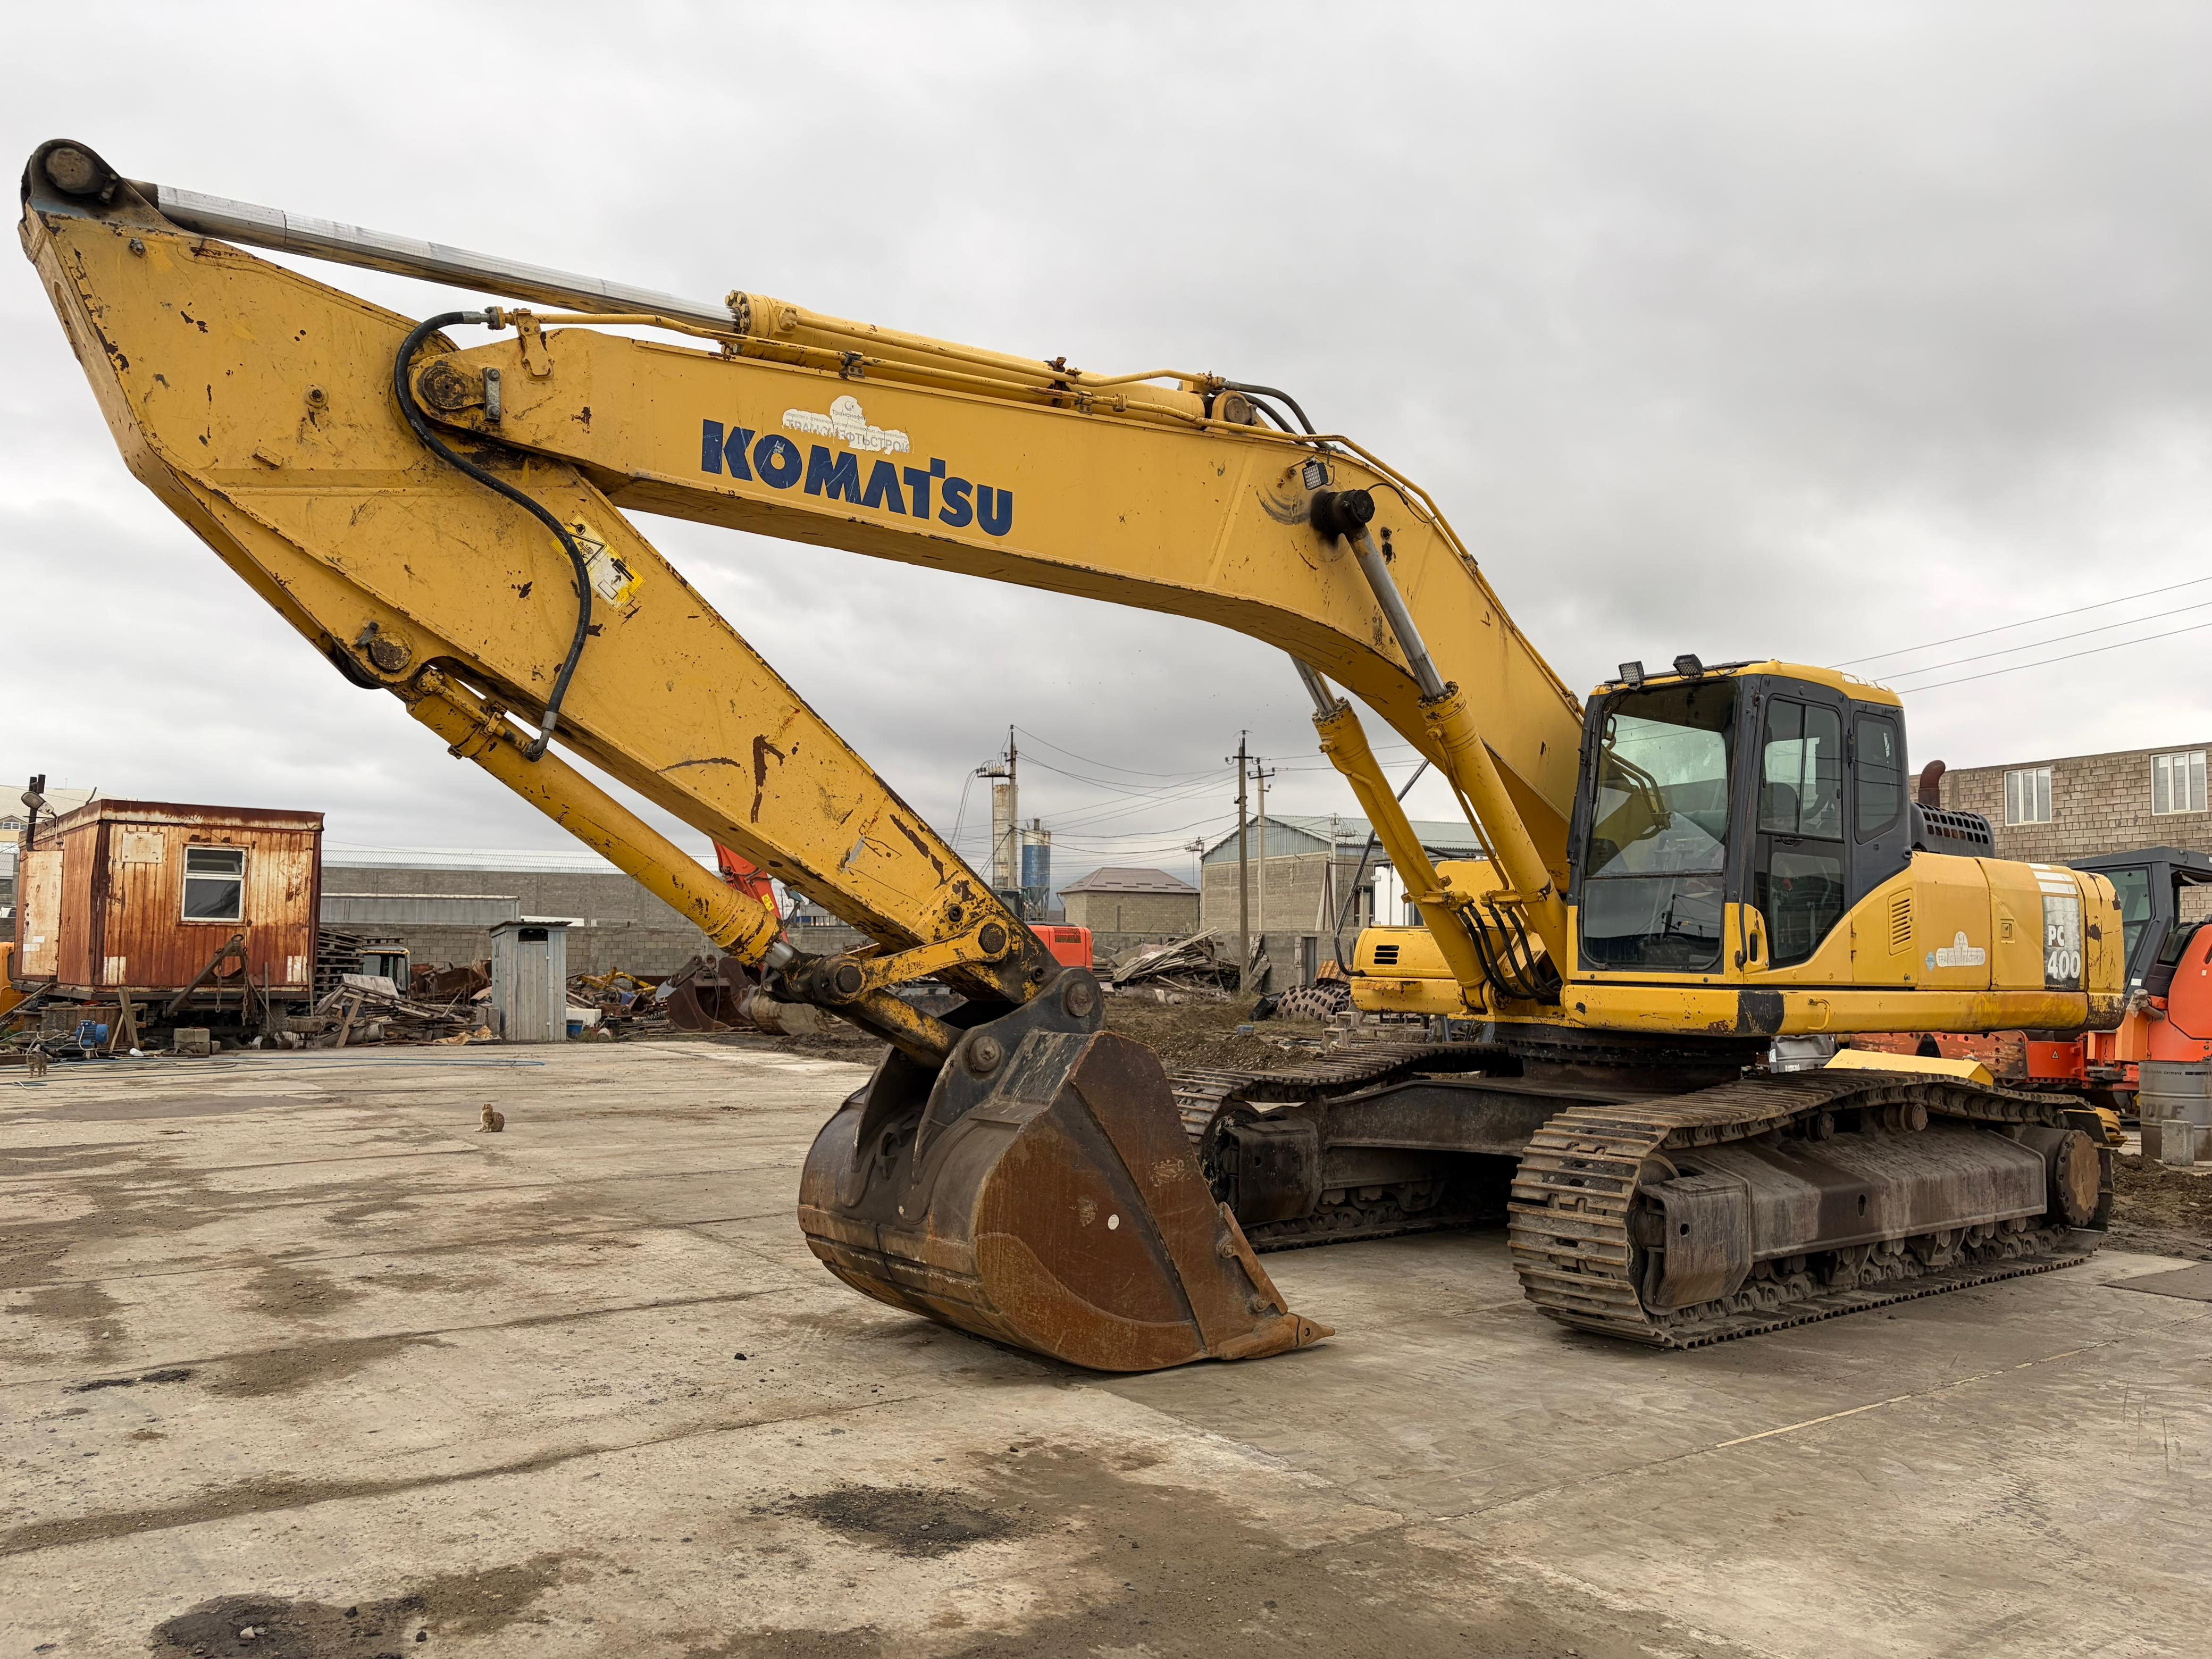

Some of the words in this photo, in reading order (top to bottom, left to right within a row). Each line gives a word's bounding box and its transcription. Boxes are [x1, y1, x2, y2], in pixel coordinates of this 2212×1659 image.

[701, 418, 1013, 537] KOMATSU
[2048, 925, 2064, 946] PC
[2048, 951, 2081, 979] 400
